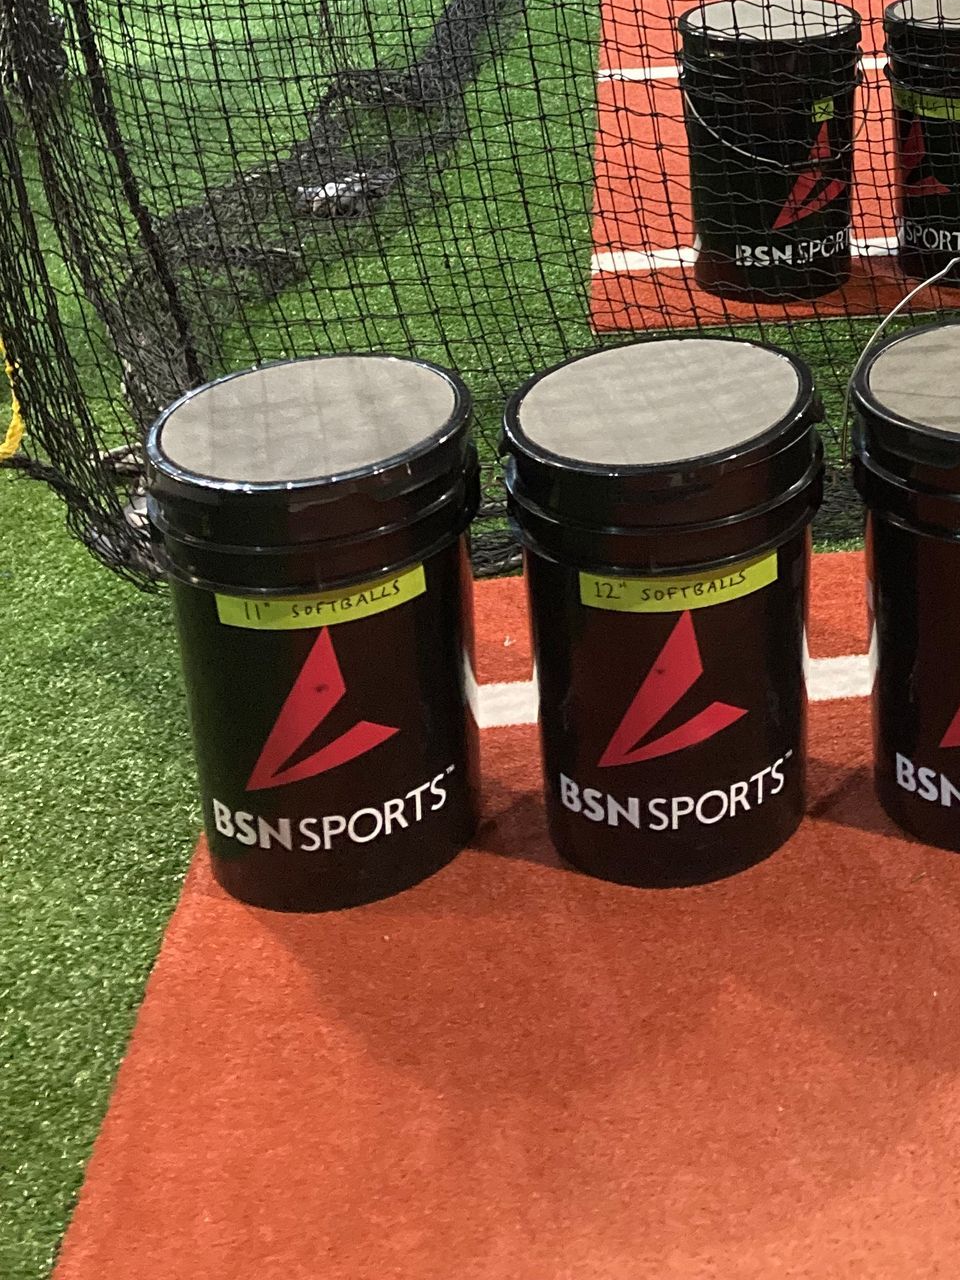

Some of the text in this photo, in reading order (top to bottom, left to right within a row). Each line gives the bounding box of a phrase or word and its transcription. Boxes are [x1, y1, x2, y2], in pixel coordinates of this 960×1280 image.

[818, 103, 830, 117] X
[735, 244, 793, 268] BSN
[291, 579, 402, 618] SOFTBALLS
[640, 570, 747, 601] SOFTBALLS
[560, 772, 640, 829] BSN
[212, 798, 293, 851] BSN
